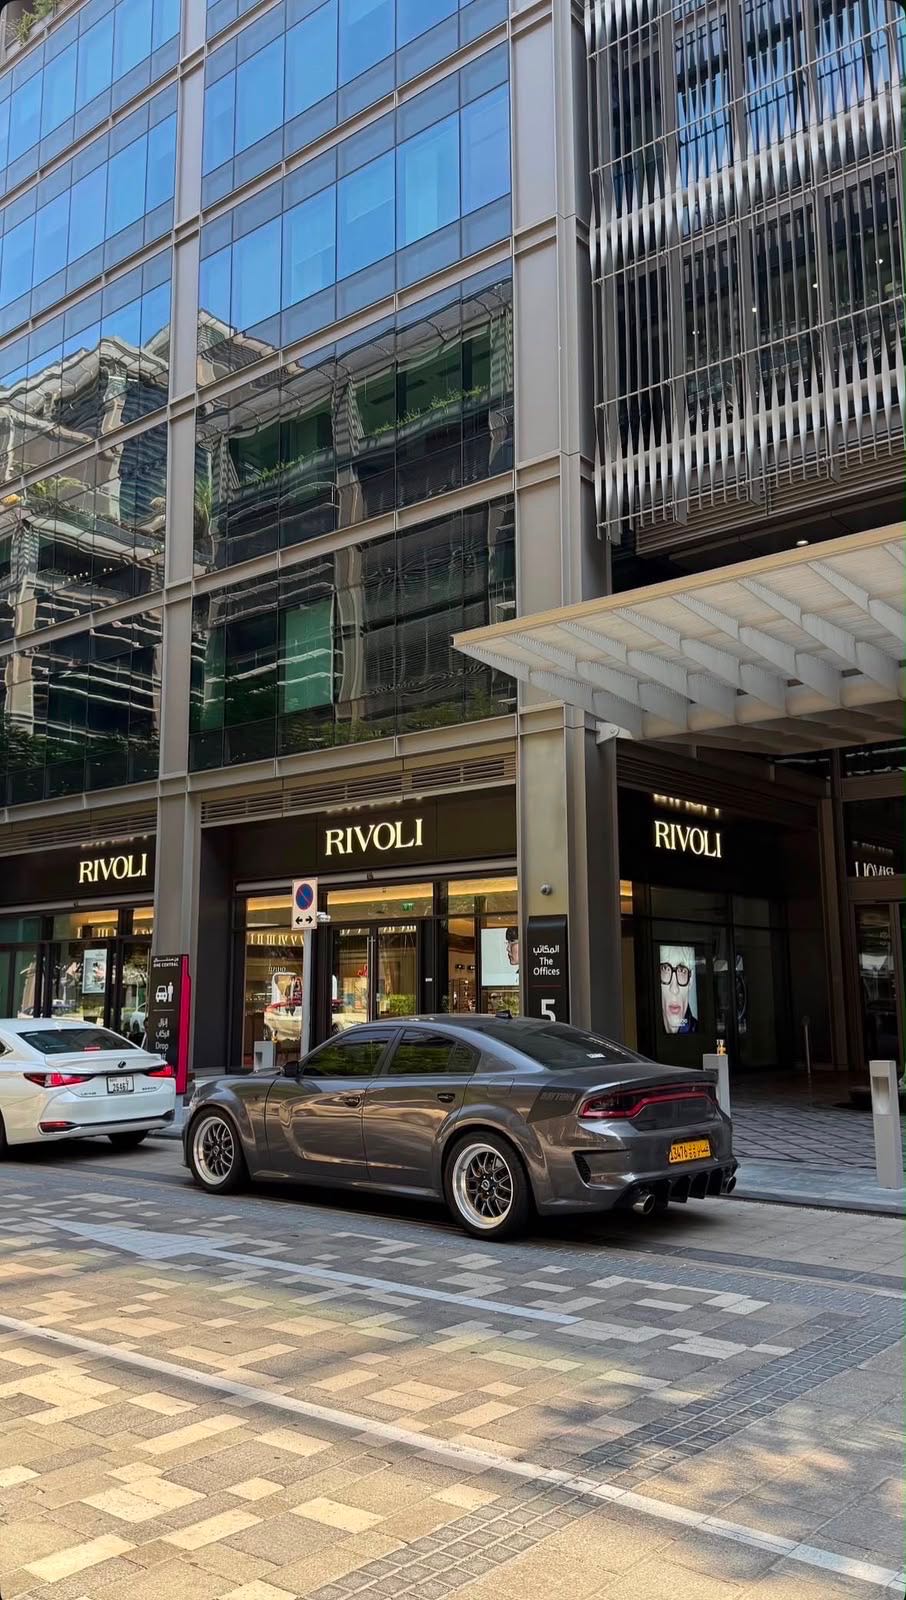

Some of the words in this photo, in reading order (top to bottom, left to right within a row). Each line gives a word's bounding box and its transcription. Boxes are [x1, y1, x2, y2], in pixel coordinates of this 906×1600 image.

[325, 818, 423, 856] RIVOLI
[654, 820, 722, 858] RIVOLI
[78, 853, 147, 884] RIVOLI
[533, 944, 560, 955] المكاتب
[539, 957, 553, 966] The
[533, 967, 560, 976] Offices
[541, 998, 556, 1023] 5
[155, 1041, 169, 1052] Drop
